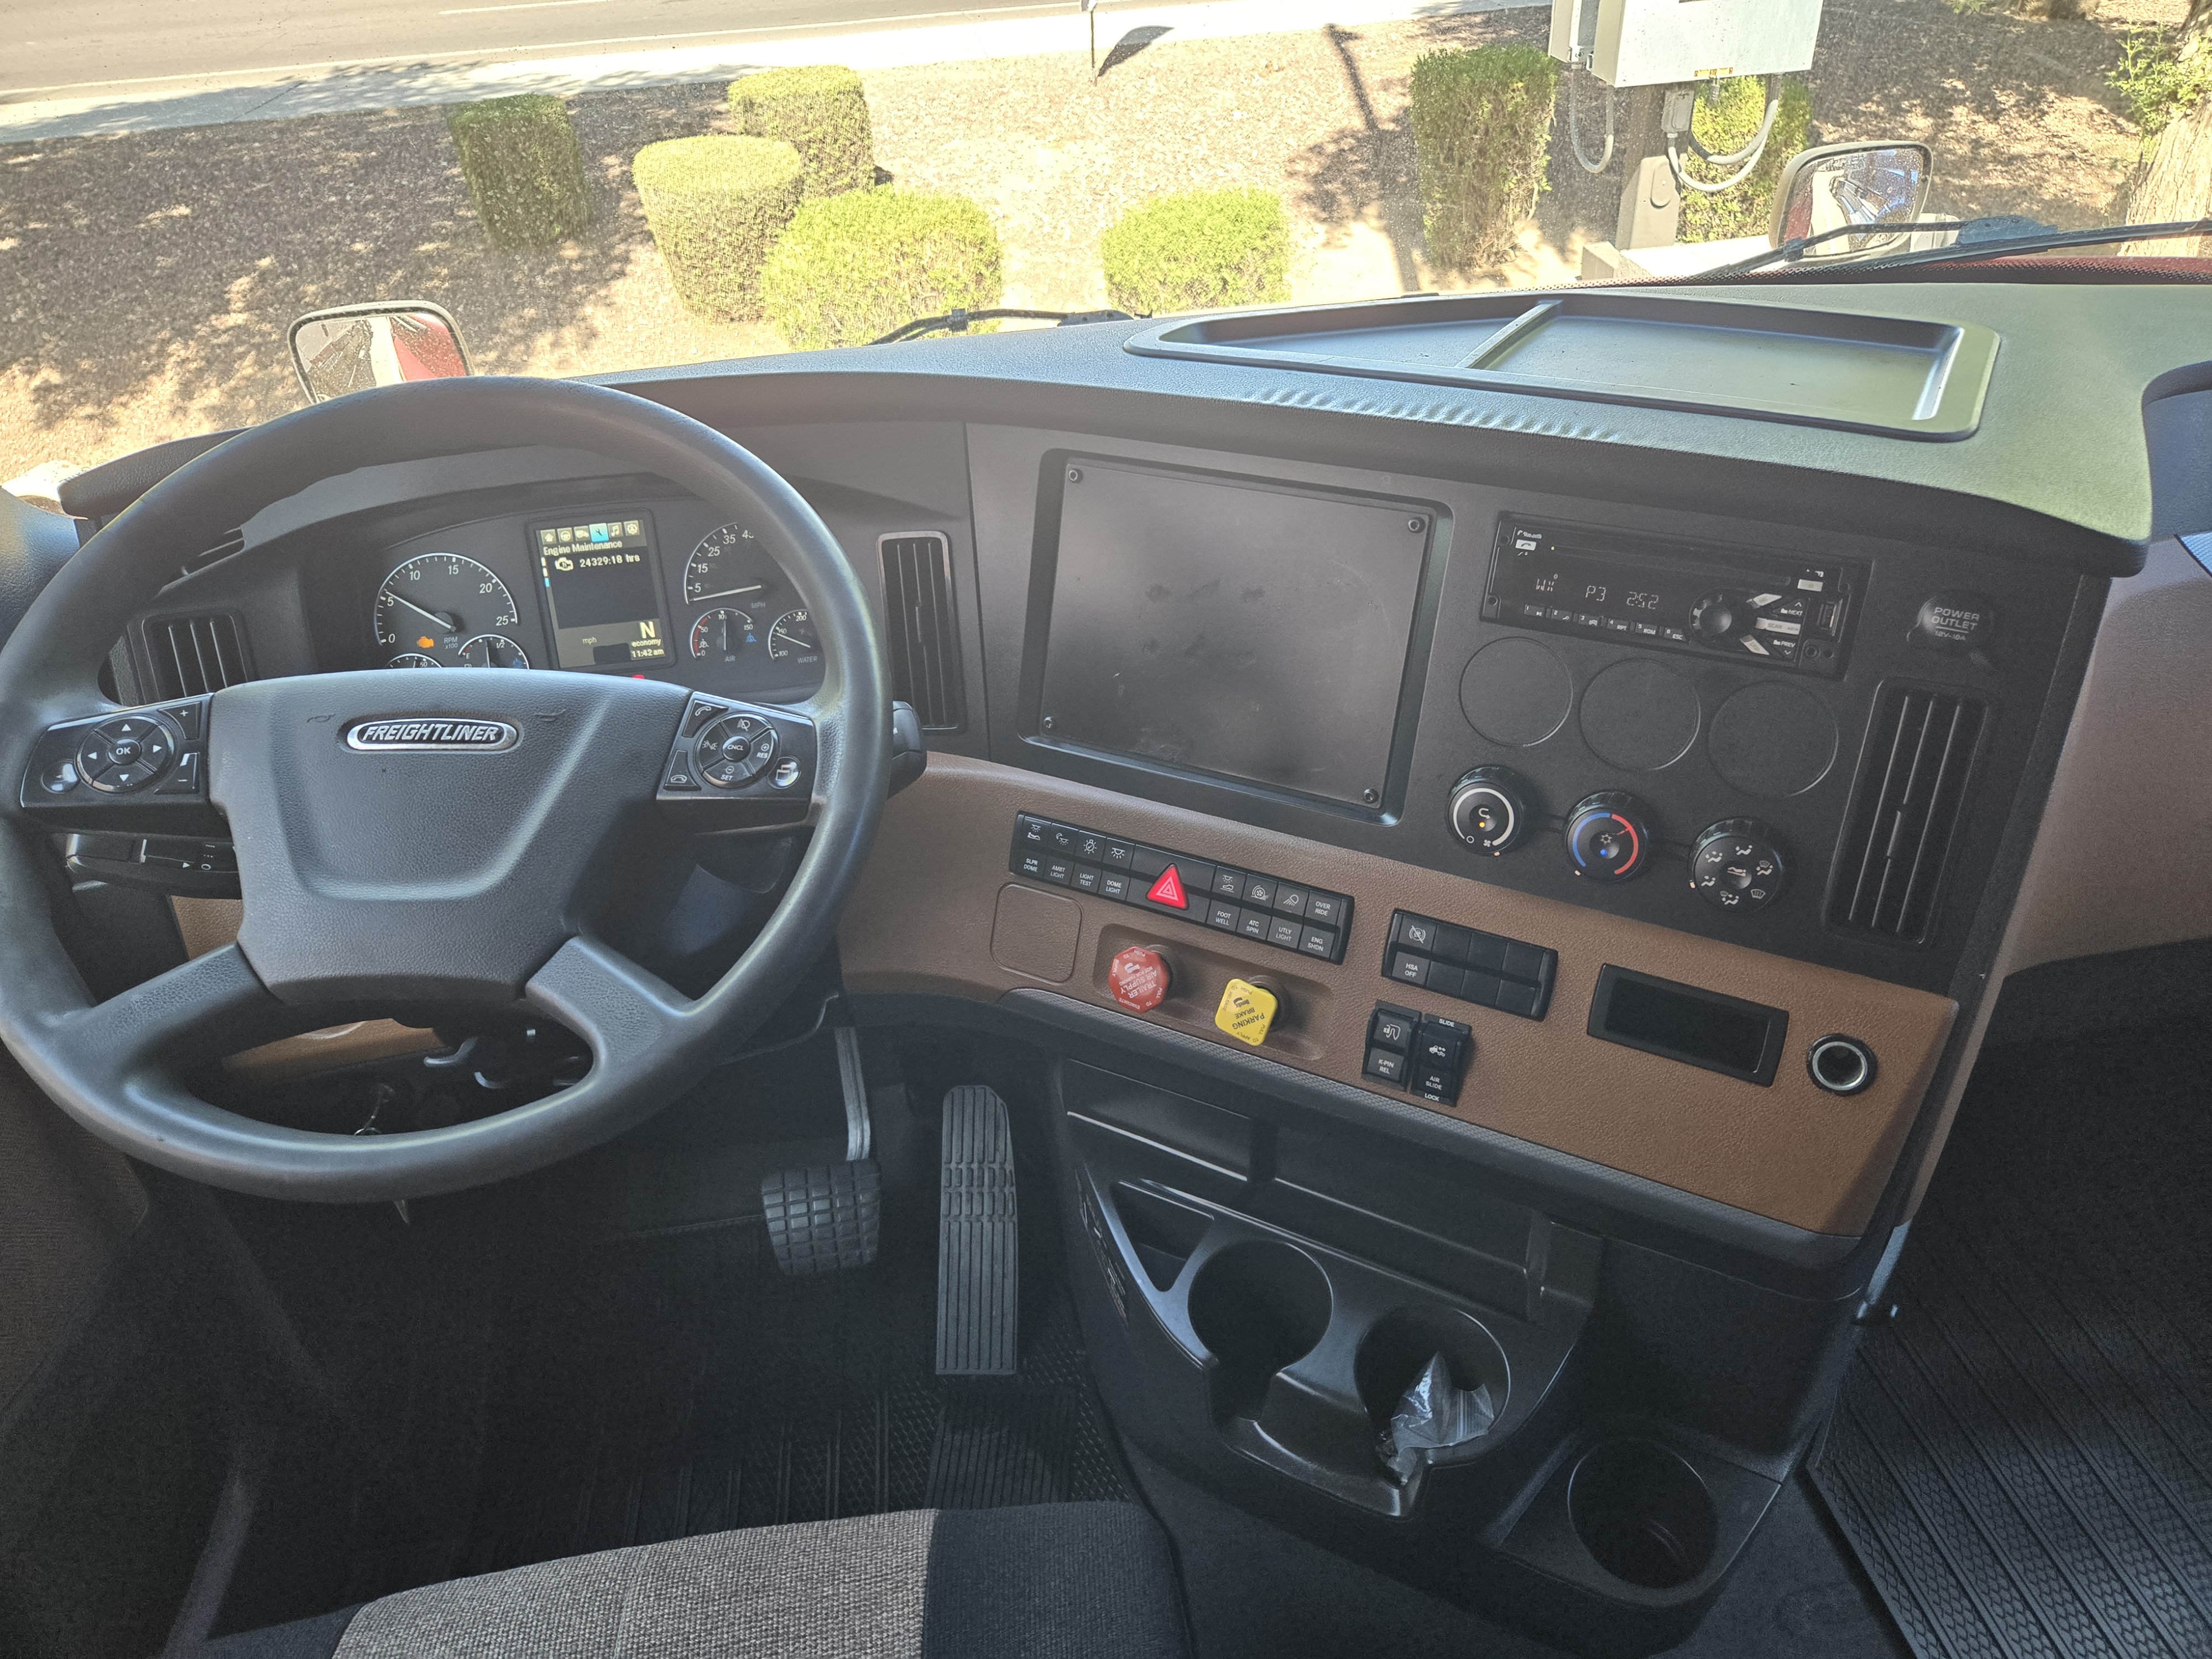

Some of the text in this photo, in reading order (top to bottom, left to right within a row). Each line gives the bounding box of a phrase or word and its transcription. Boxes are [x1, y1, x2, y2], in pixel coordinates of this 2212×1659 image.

[722, 534, 735, 544] 35
[544, 540, 623, 556] Engine Maintenance
[708, 546, 721, 557] 25
[580, 554, 640, 568] 24329:18 hrs
[448, 565, 458, 575] 15
[697, 563, 708, 573] 15
[409, 571, 420, 580] 10
[479, 583, 492, 593] 20
[695, 583, 701, 592] 5
[388, 597, 394, 606] 5
[1585, 585, 1606, 601] P3
[1626, 592, 1658, 609] 2:52
[1934, 607, 1980, 621] POWER
[495, 615, 508, 626] 25
[1932, 616, 1978, 630] OUTLET
[639, 621, 656, 639] N
[388, 634, 395, 643] 0
[582, 637, 597, 645] mph
[632, 638, 661, 648] economy
[632, 649, 653, 658] 11:42
[362, 723, 499, 741] FREIGHTLINER
[116, 747, 131, 755] OK
[1024, 864, 1038, 872] DOME
[1107, 879, 1122, 888] DOME
[1316, 901, 1331, 910] OVER
[1217, 911, 1231, 919] FOOT
[1314, 908, 1328, 916] RIDE
[1215, 917, 1229, 926] WELL
[1246, 926, 1259, 934] SPIN
[1279, 926, 1292, 935] UTLY
[1276, 933, 1292, 942] LIGHT
[1311, 936, 1323, 945] ENG
[1307, 942, 1324, 952] SHDN
[1405, 962, 1418, 972] HSA
[1119, 975, 1136, 986] PARKING
[1120, 970, 1157, 994] AIR SUPPLY
[1128, 980, 1157, 999] TRAILER
[1240, 987, 1253, 995] PUSH
[1223, 991, 1233, 1011] RELEASE
[1234, 1007, 1255, 1019] BRAKE
[1232, 1013, 1265, 1029] PARKING
[1438, 1018, 1454, 1027] SLIDE
[1236, 1031, 1250, 1040] APPLY
[1378, 1058, 1395, 1068] K-PIN
[1379, 1066, 1390, 1074] REL
[1425, 1081, 1442, 1091] SLIDE
[1425, 1093, 1439, 1102] LOCK
